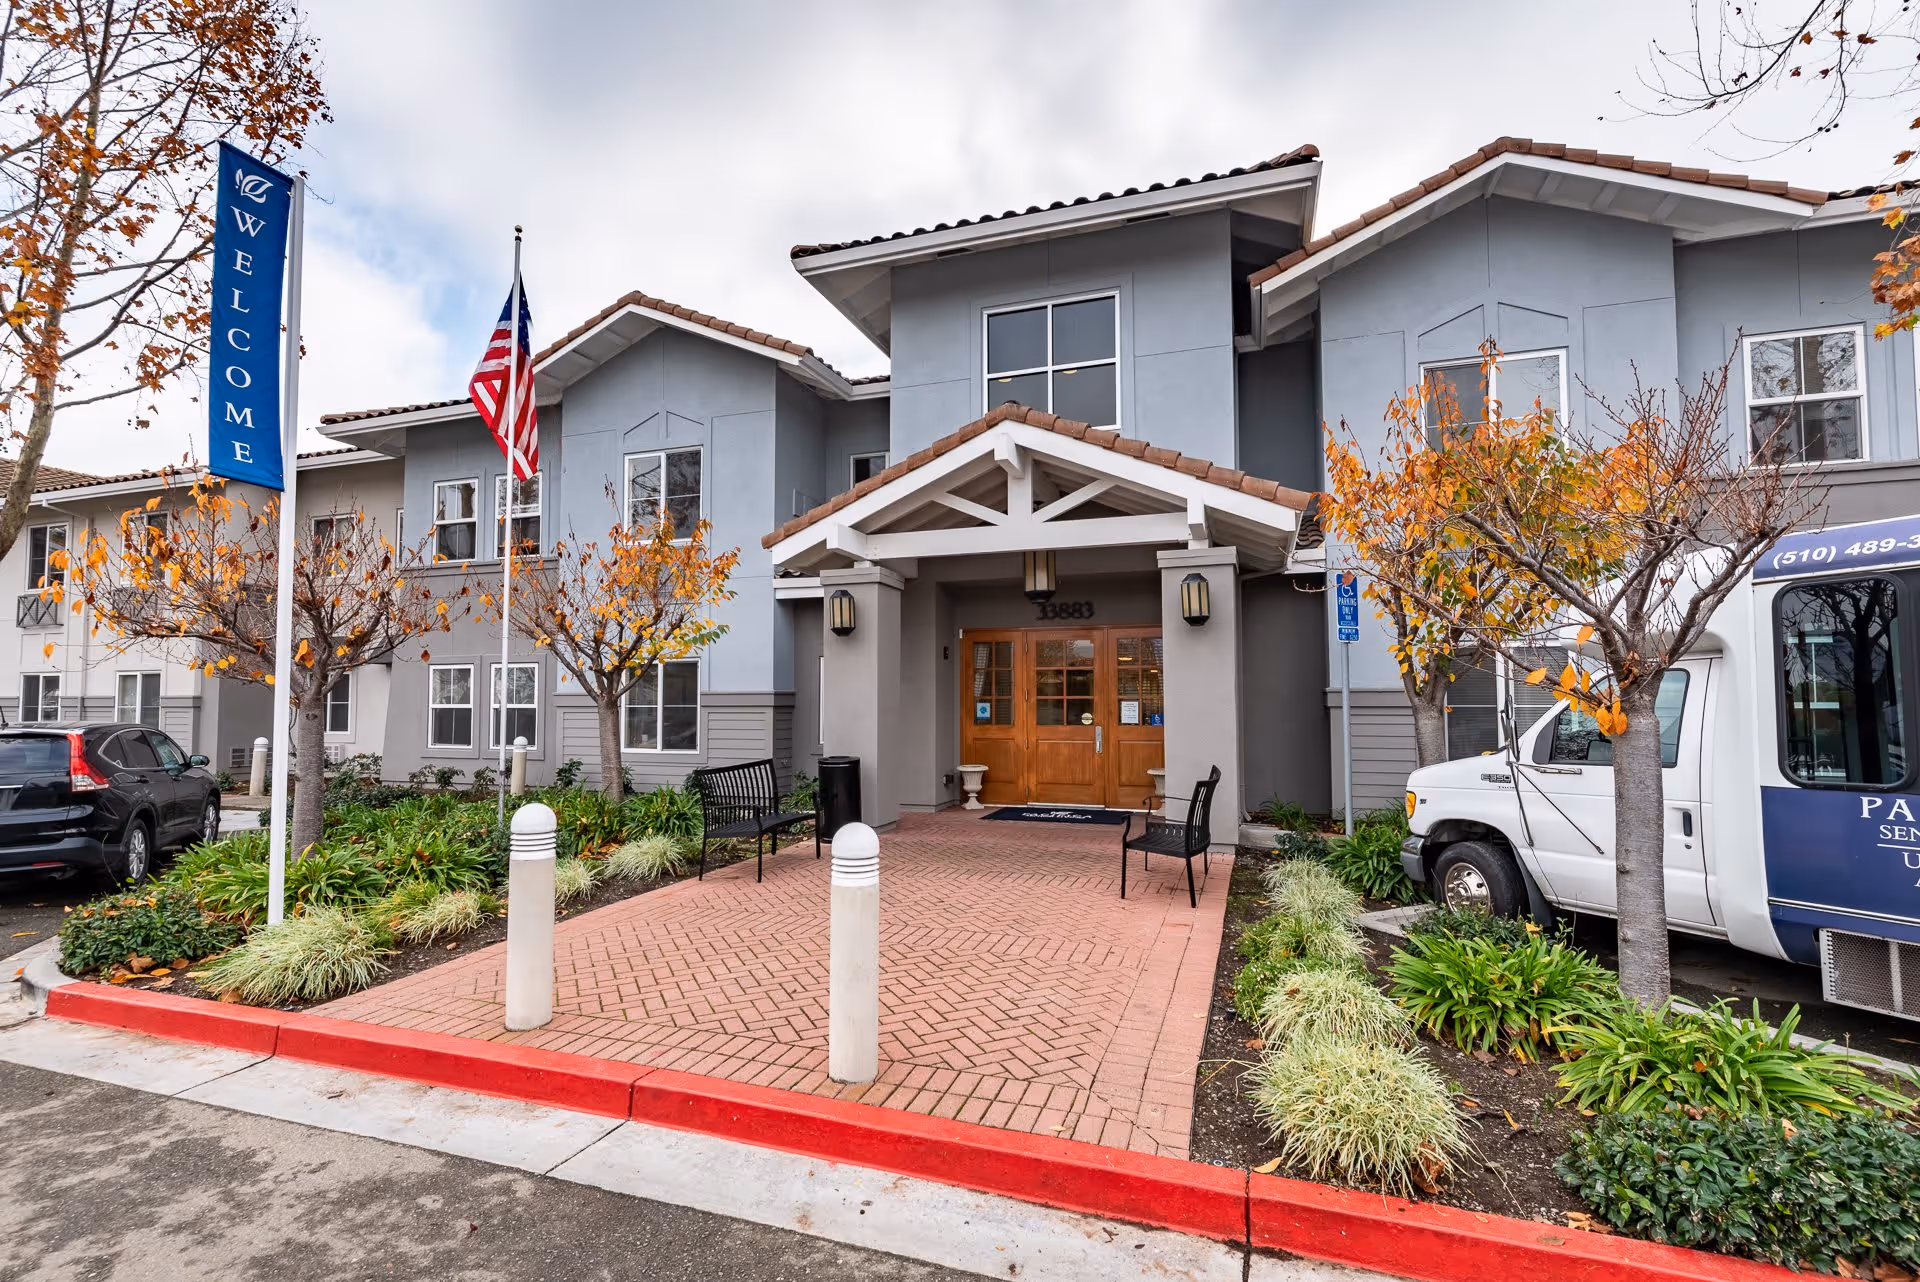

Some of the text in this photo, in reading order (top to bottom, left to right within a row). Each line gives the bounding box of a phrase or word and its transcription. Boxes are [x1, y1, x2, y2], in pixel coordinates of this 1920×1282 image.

[224, 206, 267, 464] WELCOME
[1773, 534, 1920, 569] (510) 489-3
[1338, 597, 1357, 606] PARKING
[1860, 796, 1916, 822] PA
